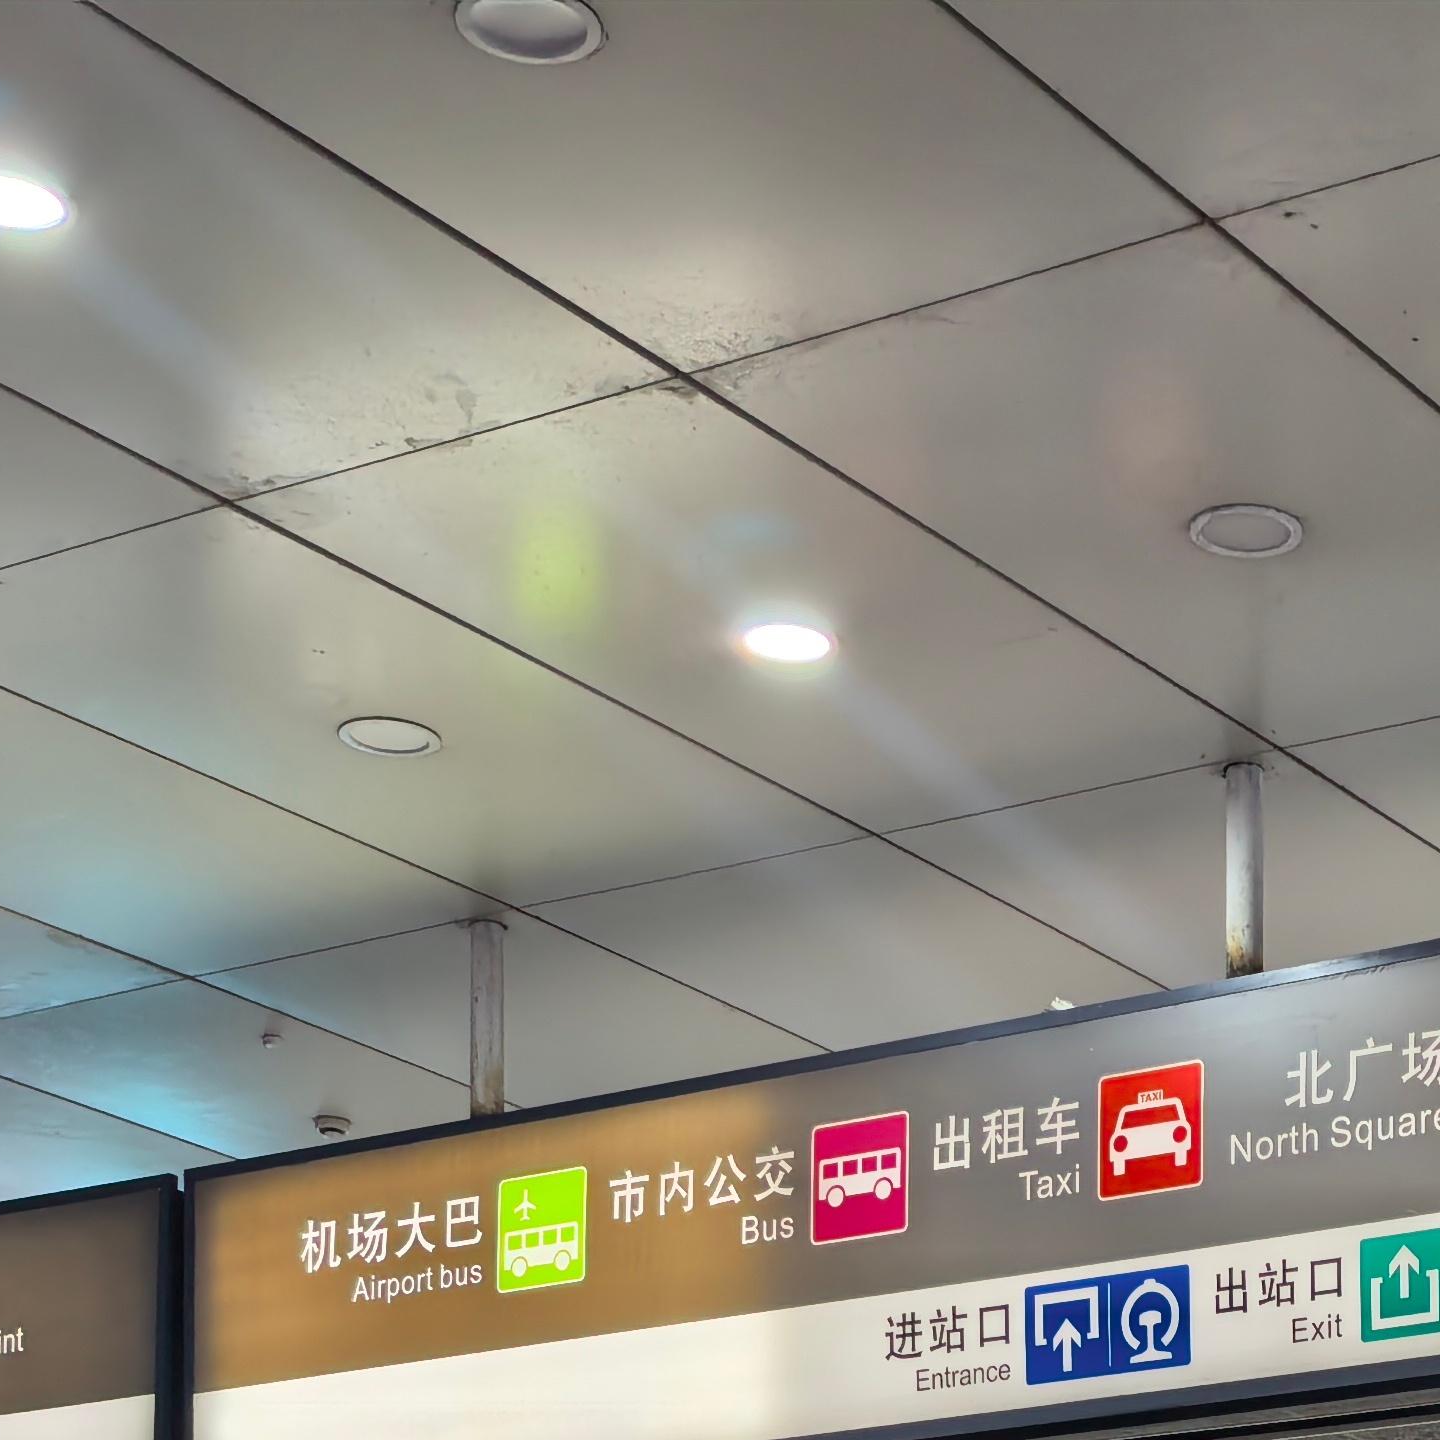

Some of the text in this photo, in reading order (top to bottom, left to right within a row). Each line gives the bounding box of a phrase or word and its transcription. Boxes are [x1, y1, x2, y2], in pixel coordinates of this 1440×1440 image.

[1139, 1090, 1163, 1105] TAXI
[932, 1096, 1081, 1171] 出租车
[1230, 1122, 1320, 1166] North
[608, 1144, 796, 1223] 市内公交
[1019, 1163, 1081, 1201] Taxi
[300, 1195, 483, 1273] 机场大巴
[741, 1214, 795, 1245] Bus
[351, 1260, 483, 1304] Airport bus
[1215, 1256, 1343, 1315] 出站口
[885, 1302, 1011, 1361] 进站口
[1291, 1313, 1343, 1344] Exit
[915, 1359, 1012, 1392] Entrance
